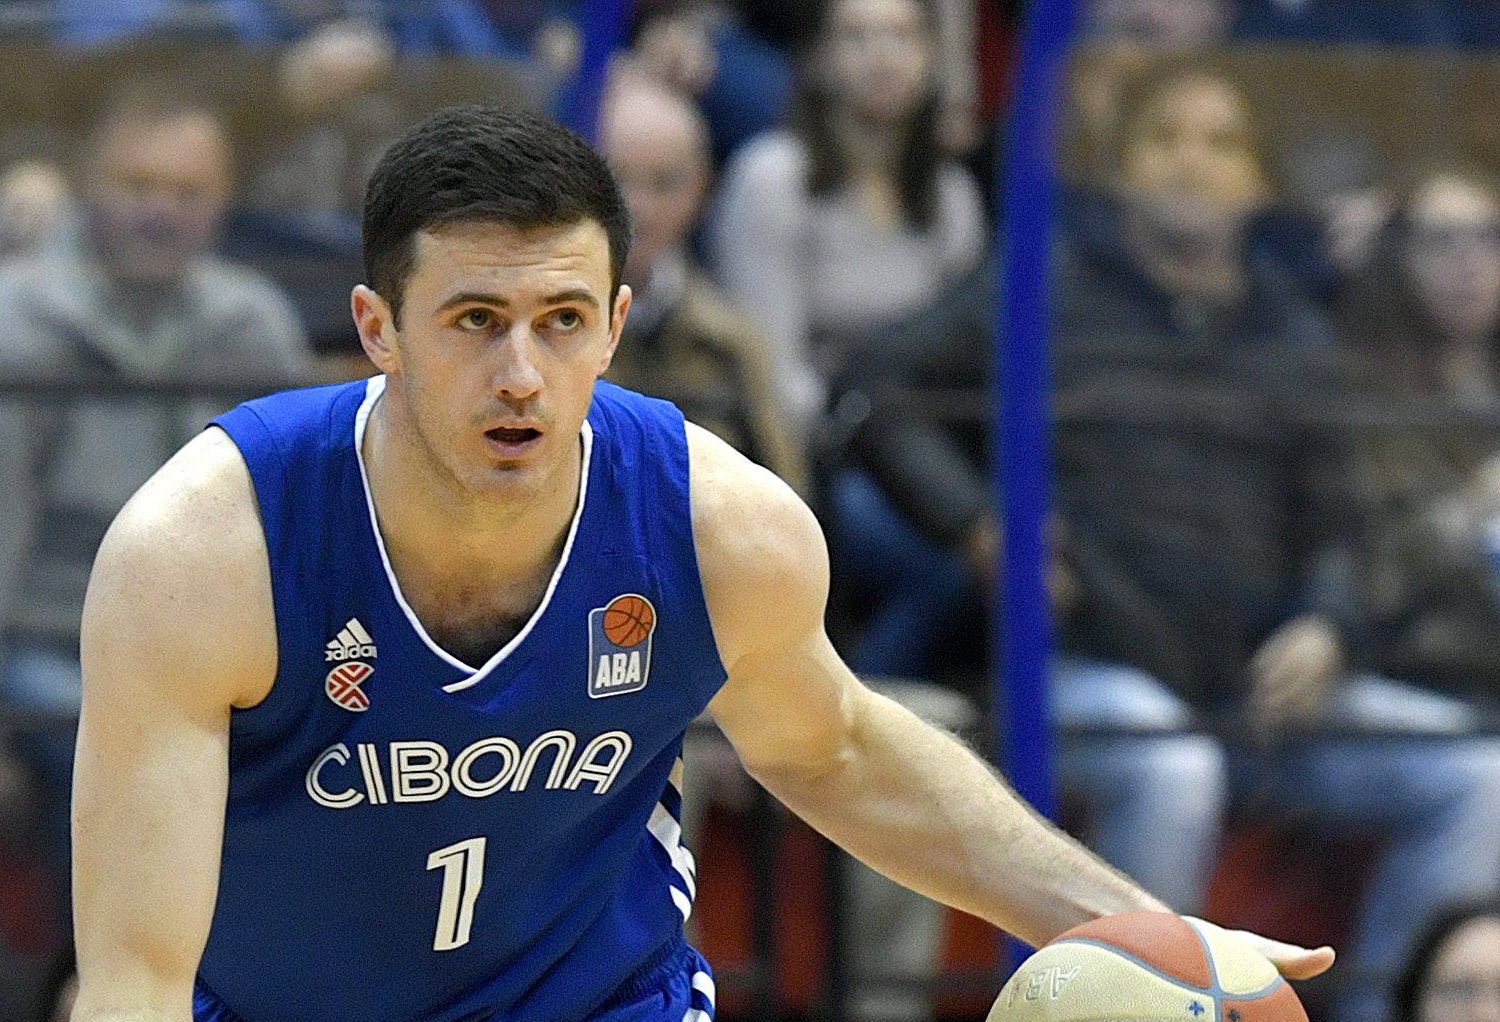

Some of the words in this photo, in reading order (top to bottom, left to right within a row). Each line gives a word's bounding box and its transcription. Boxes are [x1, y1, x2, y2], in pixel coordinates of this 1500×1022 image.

[594, 650, 641, 689] ABA
[304, 729, 634, 809] CIBONA
[425, 836, 488, 952] 1
